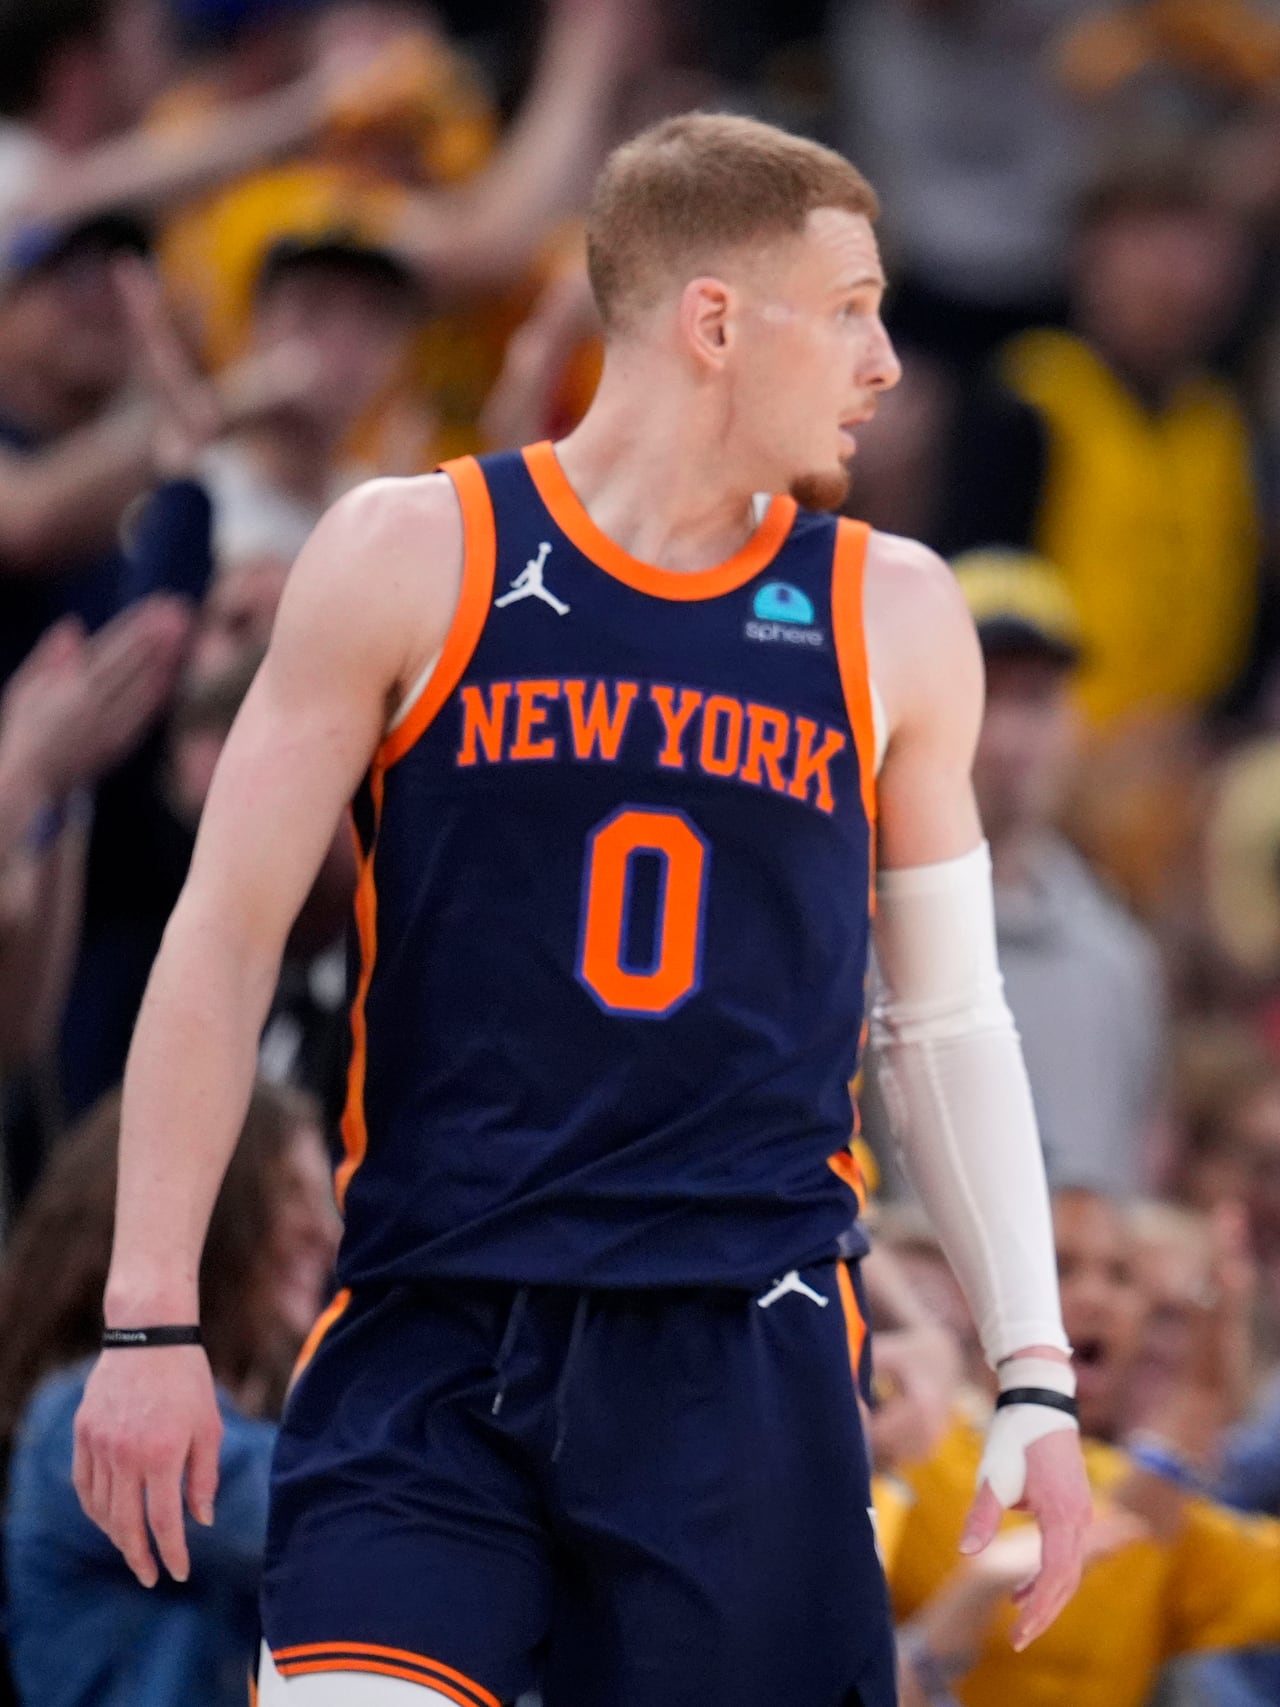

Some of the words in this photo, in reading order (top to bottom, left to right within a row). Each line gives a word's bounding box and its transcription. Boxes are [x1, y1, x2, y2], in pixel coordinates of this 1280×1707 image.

[746, 622, 822, 646] sphere
[456, 679, 639, 767] NEW
[649, 685, 846, 814] YORK
[576, 804, 710, 1019] 0
